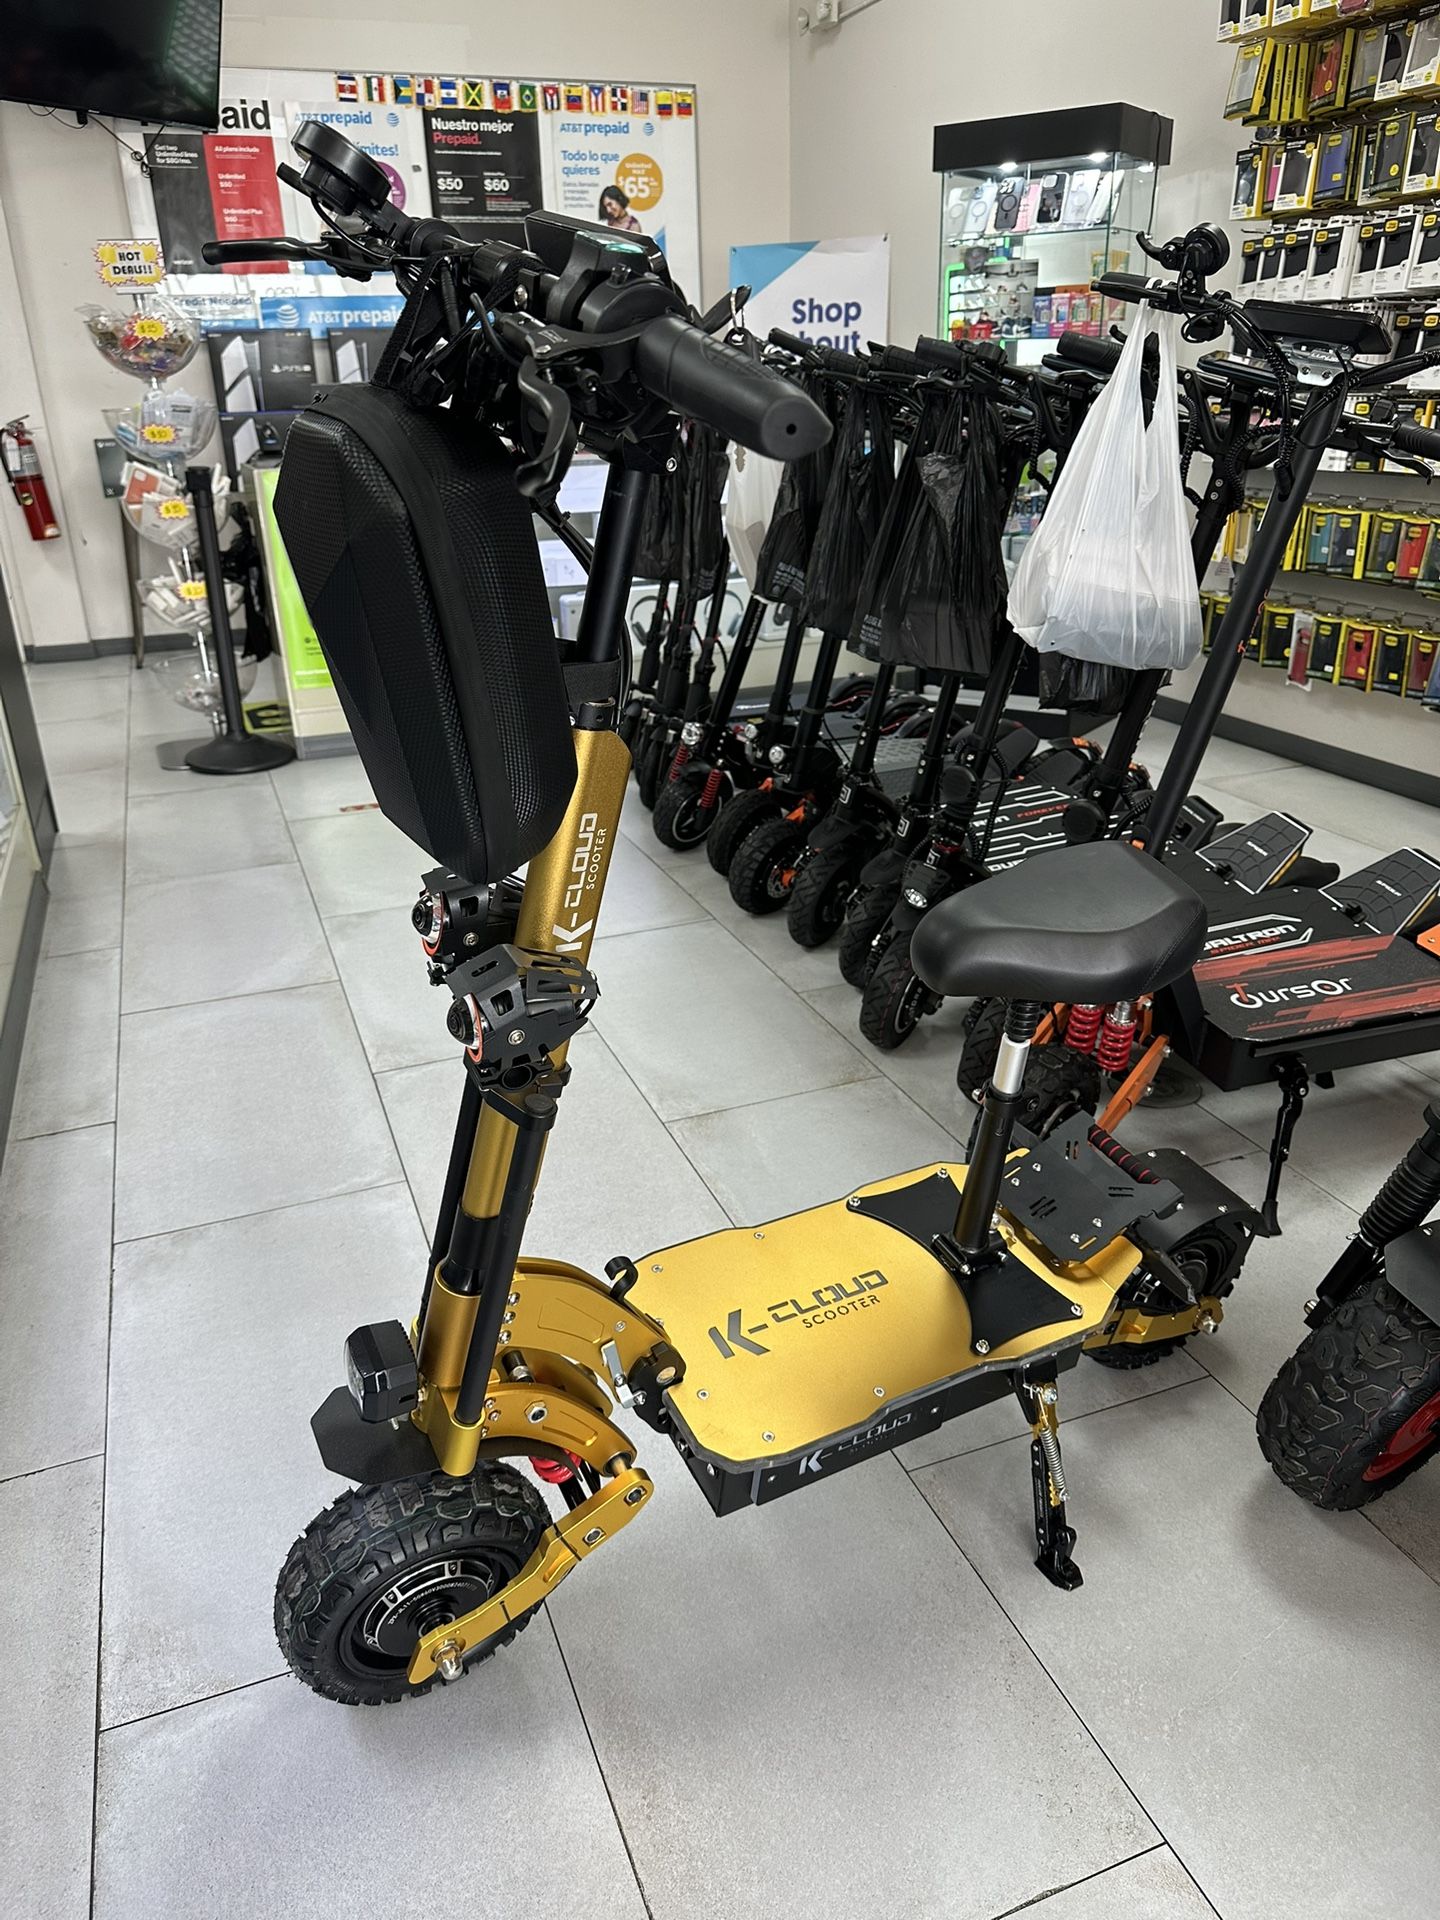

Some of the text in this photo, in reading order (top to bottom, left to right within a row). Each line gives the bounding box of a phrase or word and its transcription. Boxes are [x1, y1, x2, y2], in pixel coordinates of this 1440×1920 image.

[321, 110, 372, 127] prepaid
[431, 118, 514, 134] Nuestro mejor
[560, 121, 630, 136] AT&T prepaid
[433, 132, 482, 146] Prepaid.
[561, 151, 620, 163] Todo lo que
[562, 164, 601, 178] quieres
[437, 178, 464, 191] $50
[483, 178, 510, 192] $60
[618, 176, 651, 199] $65
[118, 251, 141, 262] HOT
[112, 265, 153, 275] DEALS!!
[308, 305, 402, 328] AT&T prepai
[792, 298, 861, 328] Shop
[586, 828, 607, 890] SCOOTER
[552, 812, 598, 953] K-CLOUD
[1203, 924, 1297, 951] ALTRON
[708, 1269, 889, 1360] K-CLOUD
[802, 1294, 881, 1329] SCOOTER
